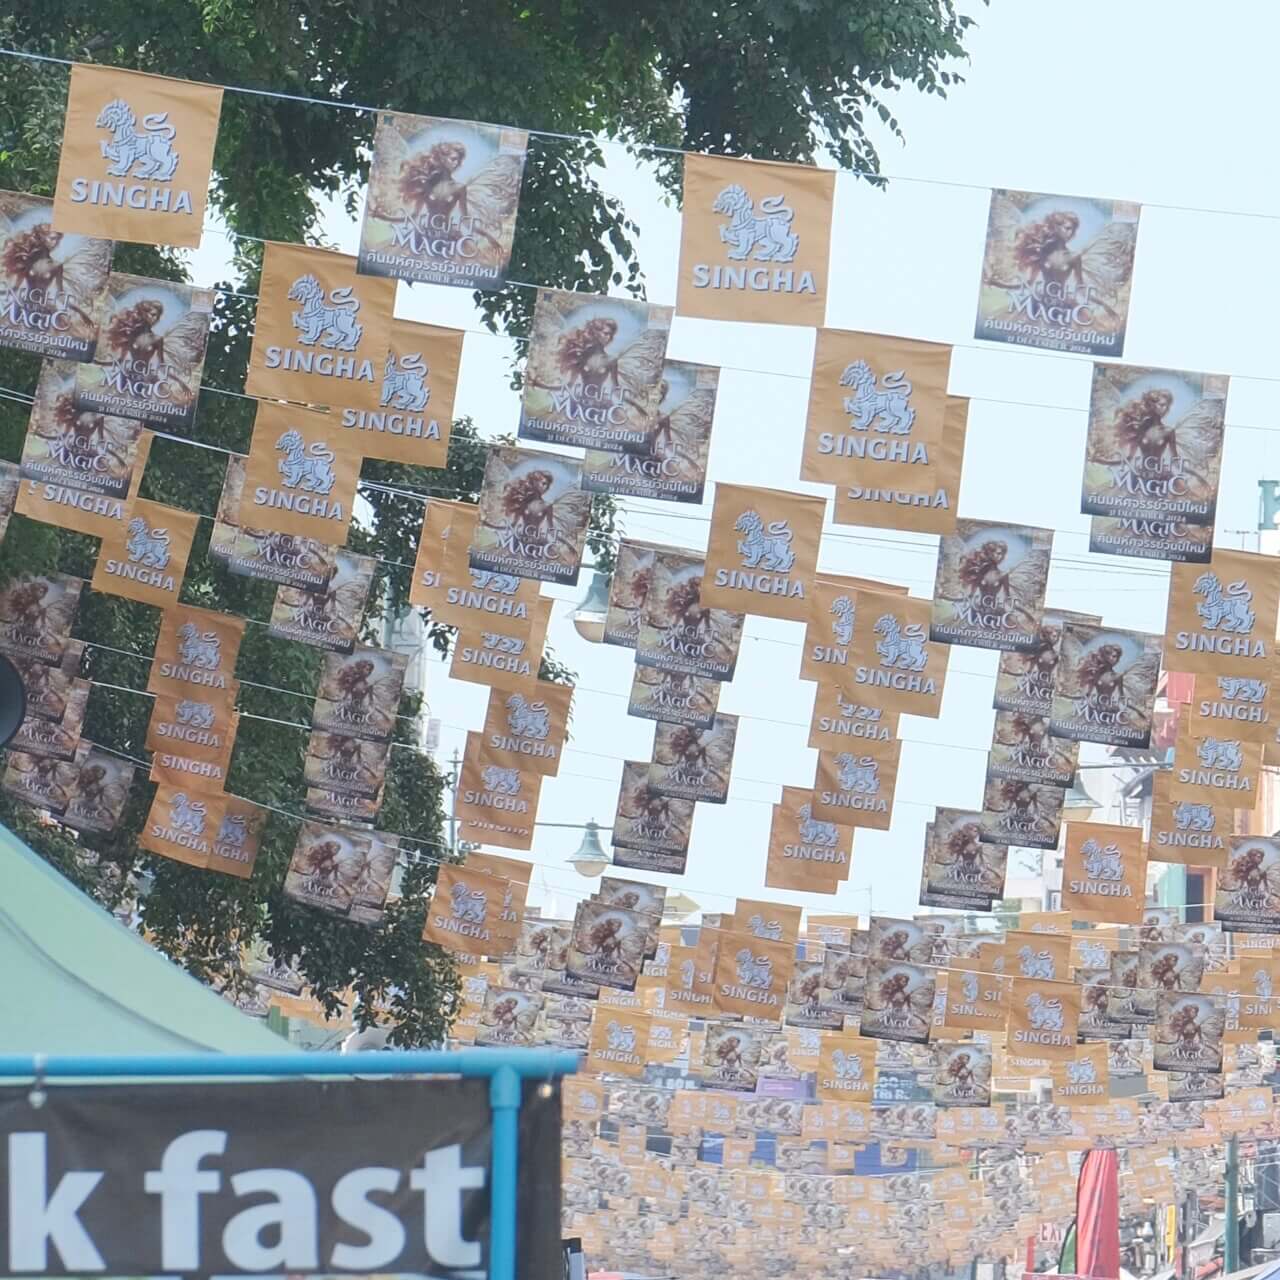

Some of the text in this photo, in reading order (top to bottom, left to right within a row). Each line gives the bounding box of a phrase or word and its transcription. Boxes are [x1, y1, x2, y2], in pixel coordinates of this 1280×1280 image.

[71, 177, 192, 215] SINGHA
[401, 208, 483, 242] NIGHT
[390, 222, 477, 261] MAGIC
[692, 264, 817, 295] SINGHA
[1020, 279, 1098, 302] NIGHT
[1007, 296, 1093, 327] MAGIC
[265, 346, 375, 382] SINGHA
[101, 366, 172, 399] MAGIC
[559, 380, 636, 403] NIGHT
[549, 391, 629, 426] MAGIC
[342, 406, 441, 441] SINGHA
[47, 442, 110, 472] MAGIC
[818, 432, 929, 465] SINGHA
[609, 451, 681, 478] MAGIC
[1110, 475, 1187, 498] MAGIC
[42, 485, 124, 521] SINGHA
[254, 487, 344, 522] SINGHA
[255, 540, 312, 570] MAGIC
[495, 532, 560, 560] MAGIC
[105, 559, 175, 593] SINGHA
[715, 569, 805, 599] SINGHA
[446, 588, 528, 620] SINGHA
[952, 602, 1017, 629] MAGIC
[658, 634, 716, 659] MAGIC
[1176, 631, 1266, 658] SINGHA
[160, 661, 226, 690] SINGHA
[460, 648, 531, 676] SINGHA
[856, 667, 937, 695] SINGHA
[1071, 701, 1129, 725] MAGIC
[156, 722, 220, 749] SINGHA
[820, 716, 891, 742] SINGHA
[490, 736, 557, 760] SINGHA
[1007, 749, 1058, 768] MAGIC
[161, 753, 223, 780] SINGHA
[1180, 768, 1252, 791] SINGHA
[463, 790, 528, 814] SINGHA
[821, 790, 888, 812] SINGHA
[152, 823, 210, 855] SINGHA
[1158, 832, 1224, 850] SINGHA
[782, 844, 848, 865] SINGHA
[1070, 880, 1133, 898] SINGHA
[434, 916, 491, 942] SINGHA
[720, 983, 779, 1007] SINGHA
[1014, 1029, 1072, 1048] SINGHA
[594, 1049, 640, 1065] SINGHA
[8, 1129, 485, 1273] k fast
